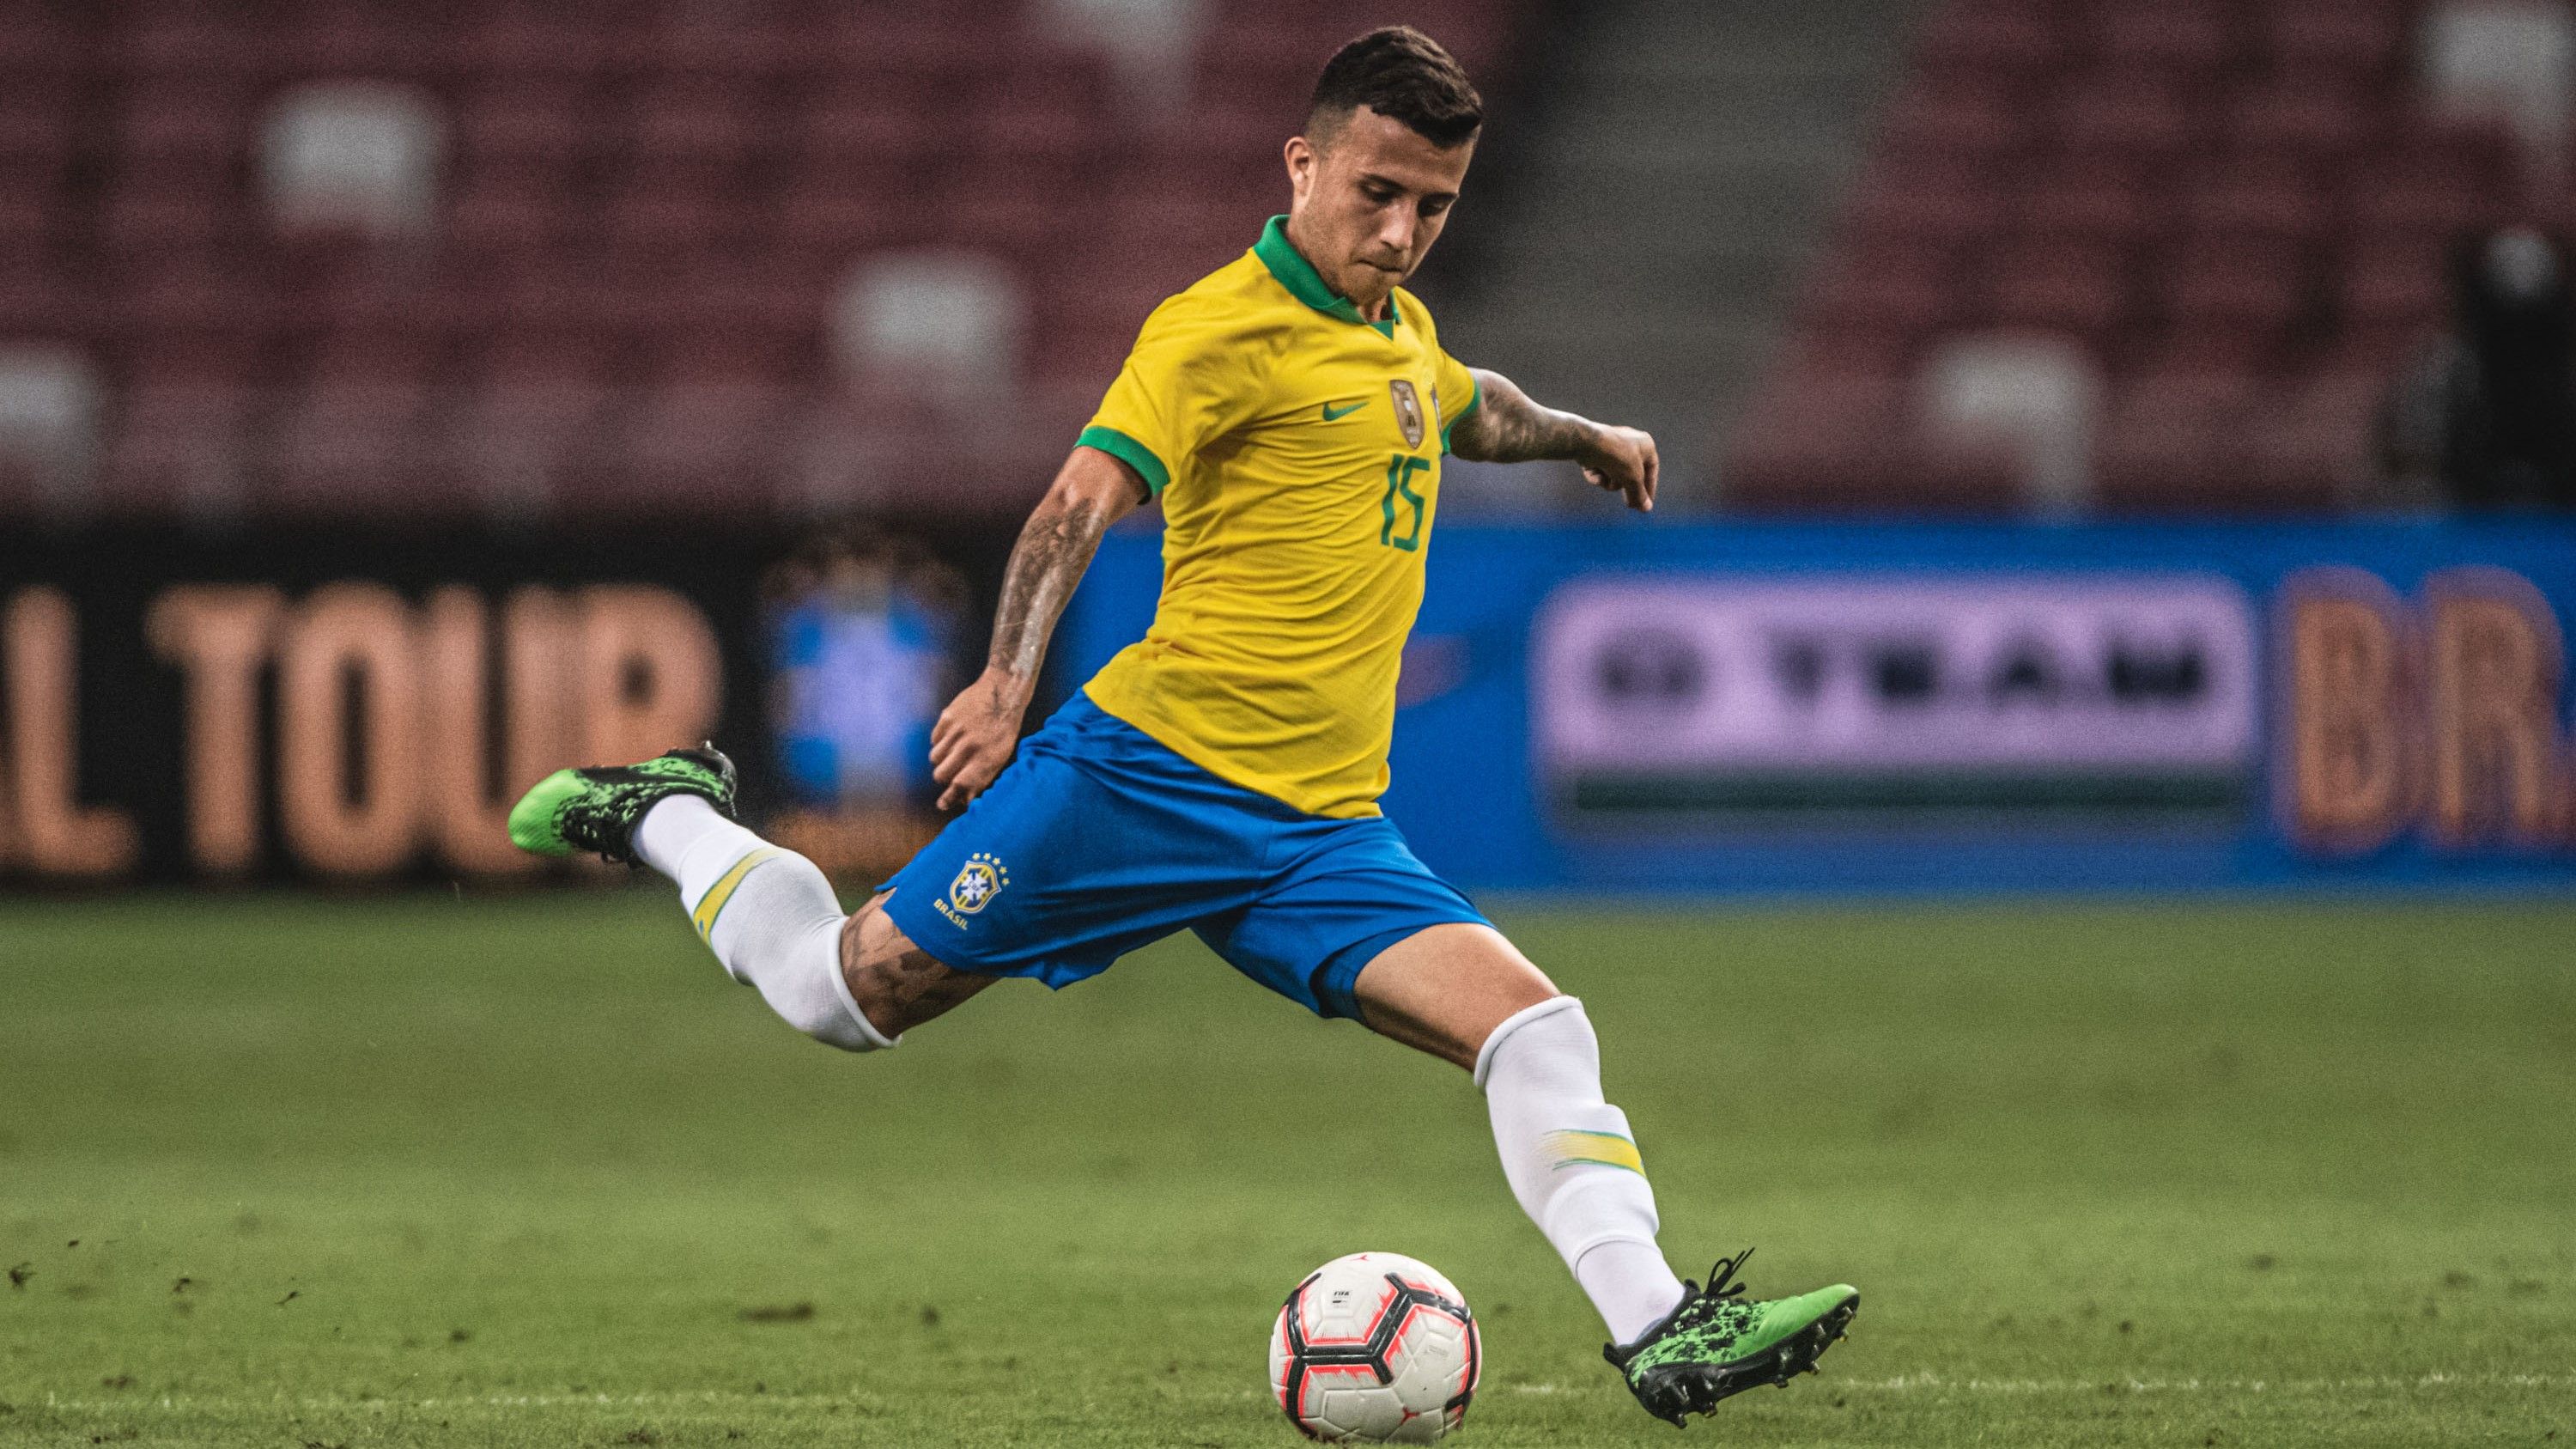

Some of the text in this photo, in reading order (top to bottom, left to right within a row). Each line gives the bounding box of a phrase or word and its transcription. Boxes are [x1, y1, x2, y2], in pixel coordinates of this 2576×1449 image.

[1381, 453, 1431, 552] 15
[0, 582, 722, 874] L TOUR
[2272, 565, 2576, 852] BR
[933, 898, 968, 930] BRASIL
